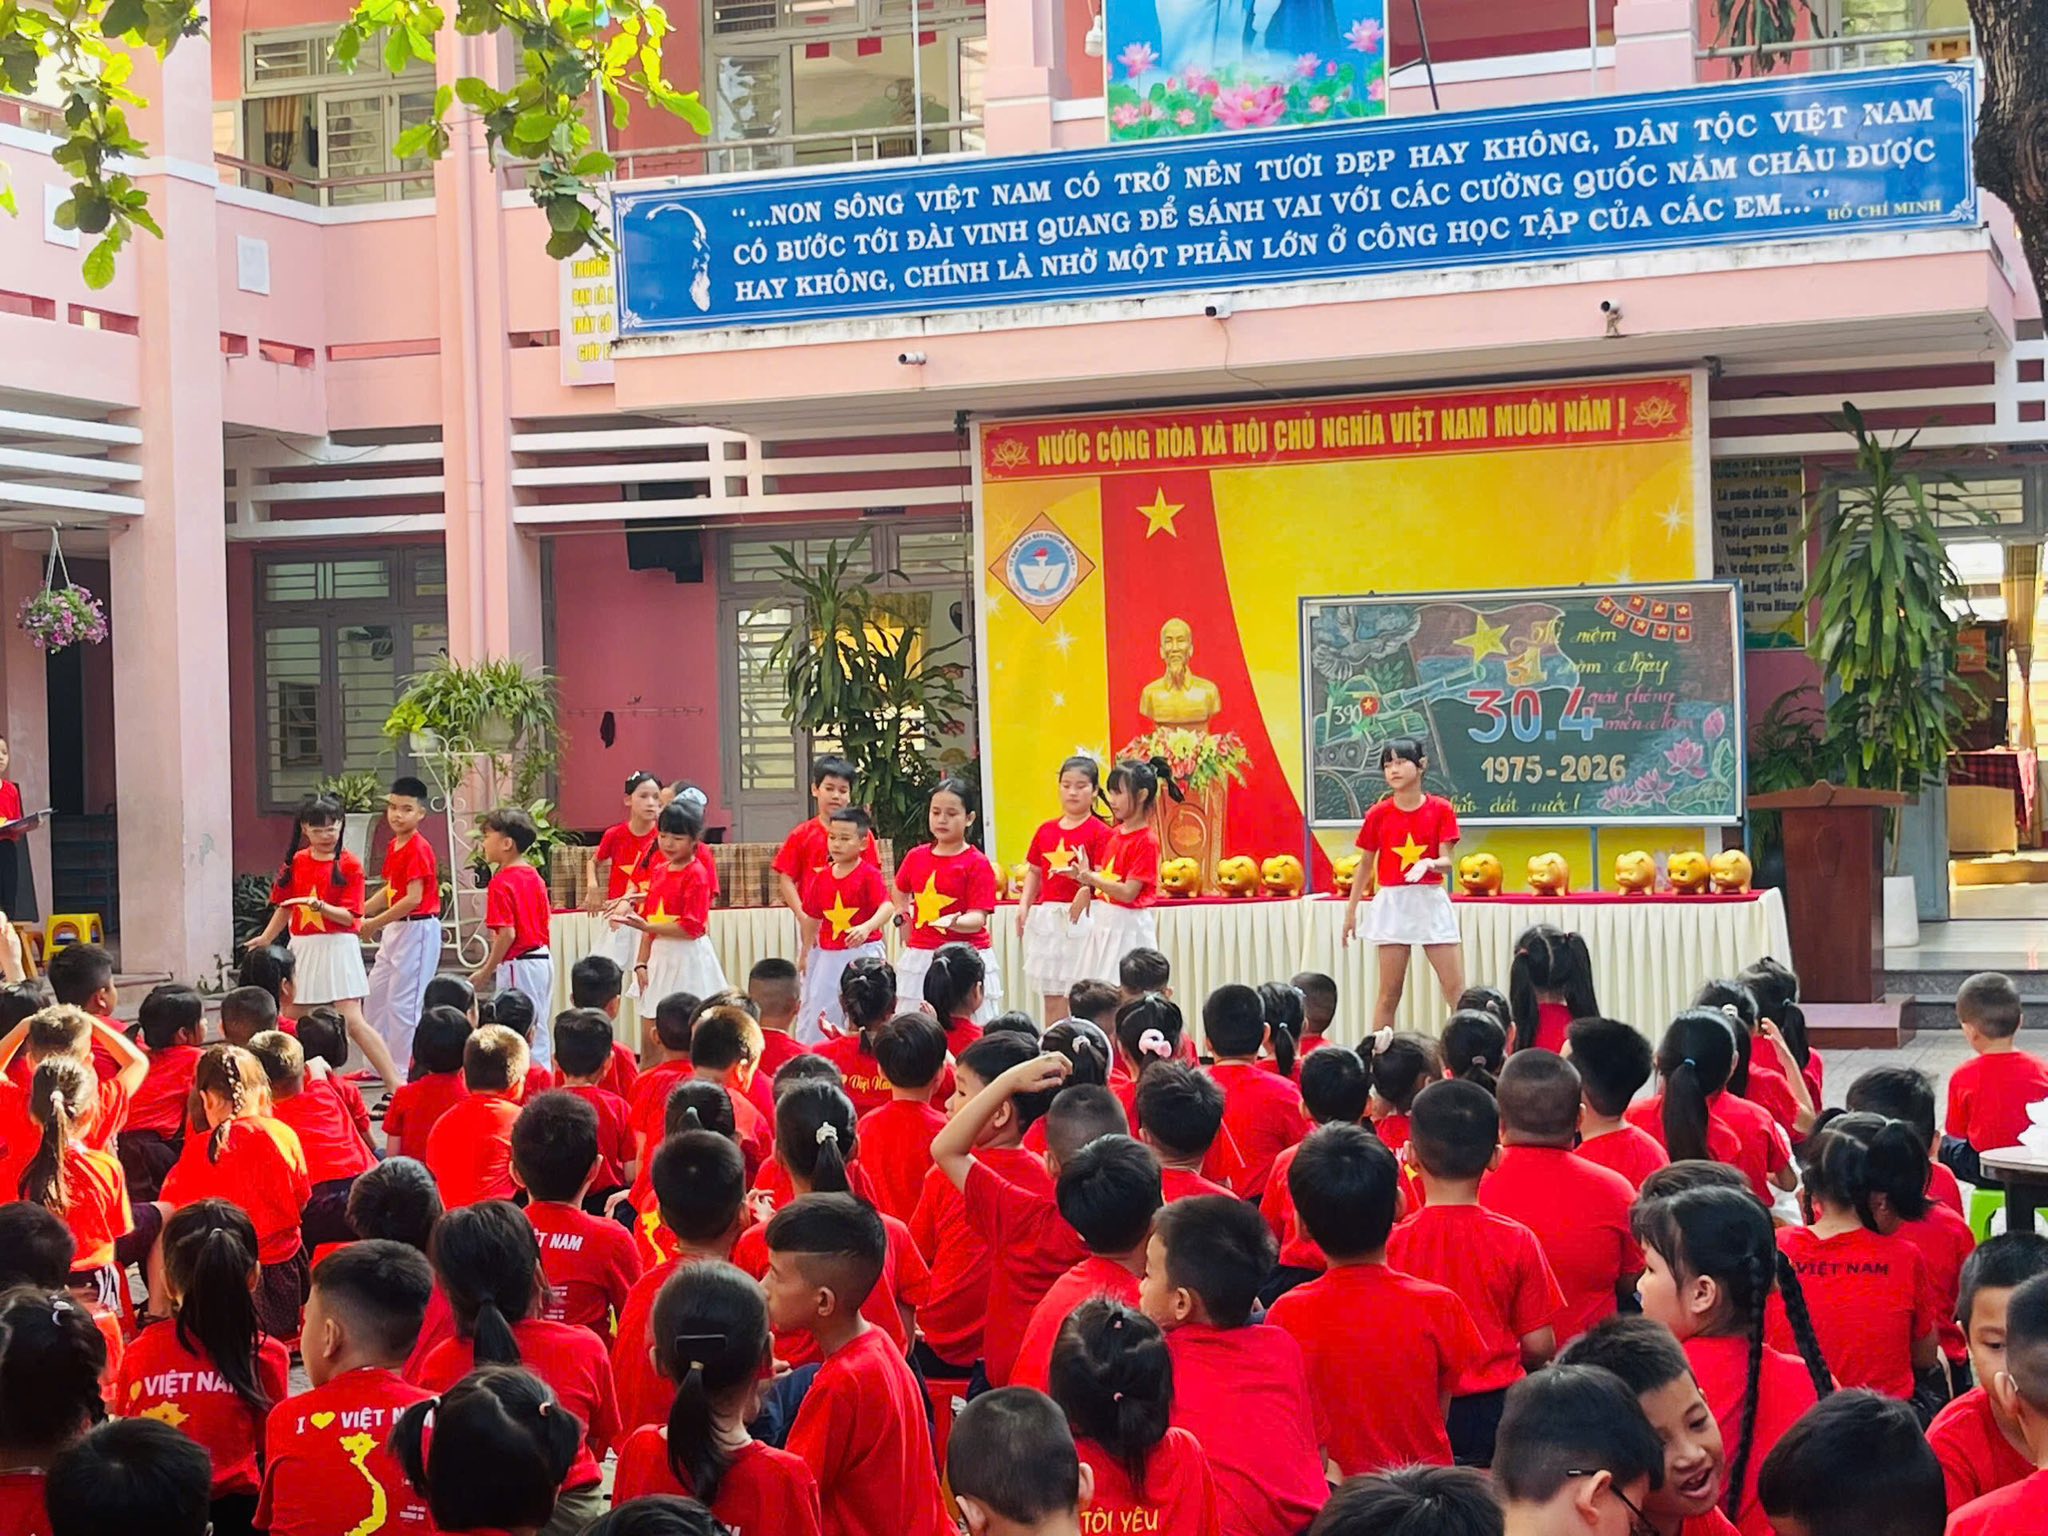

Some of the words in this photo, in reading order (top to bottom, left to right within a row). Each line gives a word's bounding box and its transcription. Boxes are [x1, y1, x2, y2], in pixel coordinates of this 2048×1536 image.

[834, 191, 905, 220] SÔNG
[915, 183, 980, 214] VIỆT
[991, 180, 1052, 206] NAM
[1064, 170, 1100, 199] CÓ
[1113, 161, 1172, 196] TRỞ
[1184, 159, 1242, 189] NÊN
[1255, 153, 1323, 181] TƯƠI
[1336, 149, 1396, 177] ĐẸP
[1408, 141, 1470, 168] HAY
[1483, 129, 1599, 161] KHÔNG,
[1614, 118, 1679, 149] DÂN
[1693, 111, 1758, 145] TỘC
[1770, 101, 1849, 137] VIỆT
[1862, 97, 1934, 127] NAM
[733, 237, 768, 265] CÓ
[776, 232, 846, 262] BƯỚC
[853, 226, 899, 255] TỚI
[906, 222, 955, 251] ĐÀI
[961, 220, 1029, 246] VINH
[1037, 211, 1131, 245] QUANG
[1139, 195, 1179, 231] ĐỂ
[1188, 197, 1265, 227] SÁNH
[1272, 194, 1322, 219] VAI
[1330, 184, 1381, 214] VỚI
[1391, 179, 1450, 209] CÁC
[1460, 171, 1563, 203] CƯỜNG
[1573, 155, 1658, 199] QUỐC
[1667, 153, 1738, 184] NĂM
[1747, 144, 1836, 177] CHÂU
[1845, 136, 1936, 169] ĐƯỢC
[1893, 199, 1942, 215] MINH
[735, 277, 788, 302] HAY
[795, 267, 896, 294] KHÔNG,
[904, 259, 990, 288] CHÍNH
[997, 252, 1033, 280] LÀ
[1041, 246, 1098, 277] NHỜ
[1107, 243, 1169, 274] MỘT
[1176, 229, 1253, 266] PHẦN
[1262, 230, 1318, 259] LỚN
[1328, 224, 1347, 253] Ở
[1357, 222, 1438, 251] CÔNG
[1447, 217, 1510, 246] HỌC
[1519, 207, 1579, 240] TẬP
[1588, 199, 1652, 231] CỦA
[1660, 194, 1724, 225] CÁC
[1037, 428, 1091, 466] NƯỚC
[1096, 424, 1150, 468] CỘNG
[1155, 422, 1197, 459] HÒA
[1201, 419, 1228, 456] XÃ
[1232, 416, 1268, 459] HỘI
[1273, 410, 1316, 450] CHỦ
[1321, 409, 1386, 448] NGHĨA
[1390, 404, 1435, 449] VIỆT
[1441, 407, 1488, 441] NAM
[1494, 397, 1557, 438] MUÔN
[1564, 393, 1612, 433] NĂM
[1333, 704, 1362, 725] 390
[1467, 686, 1604, 745] 30.4
[549, 1232, 584, 1252] NAM
[1795, 1260, 1840, 1278] VIỆT
[1846, 1262, 1890, 1276] NAM
[143, 1368, 194, 1399] VIỆT
[340, 1406, 386, 1431] VIỆT
[1080, 1506, 1114, 1535] TÔI
[1119, 1505, 1159, 1534] YÊU
